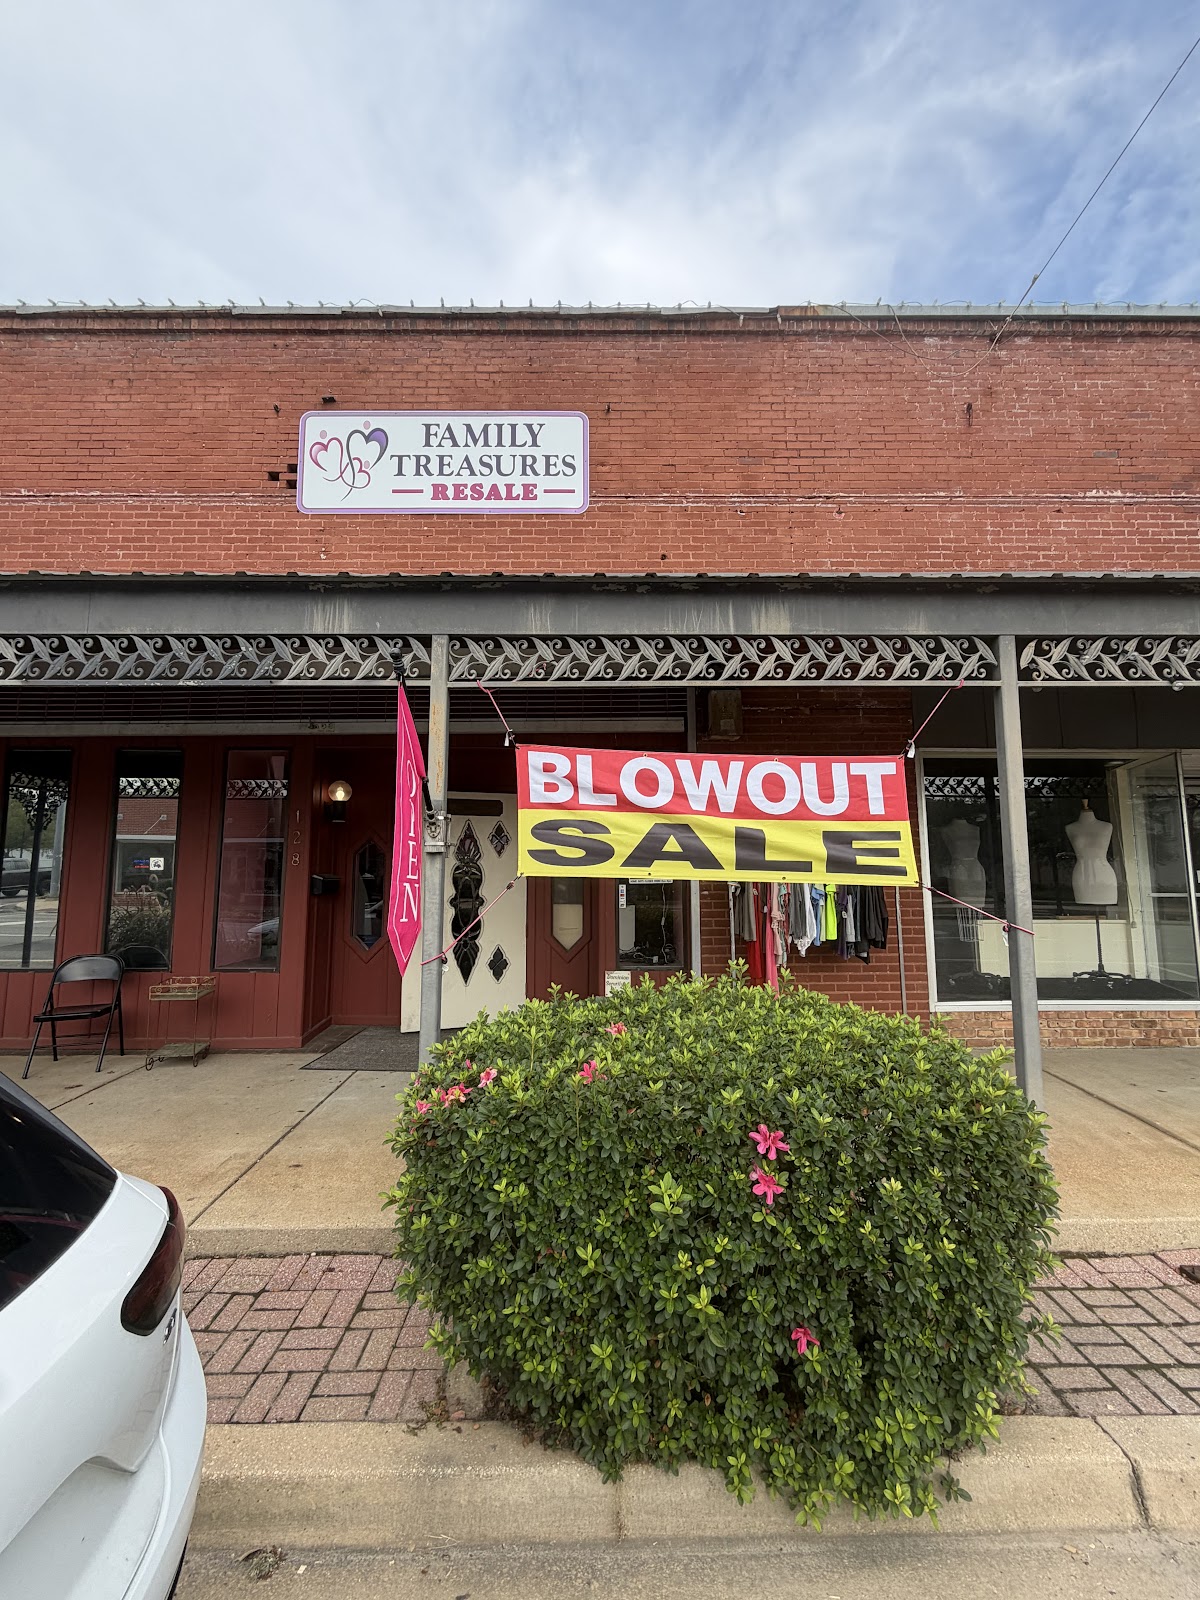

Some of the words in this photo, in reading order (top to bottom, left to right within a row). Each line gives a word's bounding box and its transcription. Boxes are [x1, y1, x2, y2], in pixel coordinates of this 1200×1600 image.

[421, 423, 546, 448] FAMILY
[389, 454, 577, 477] TREASURES
[430, 483, 538, 501] RESALE
[527, 750, 897, 817] BLOWOUT
[526, 818, 908, 877] SALE
